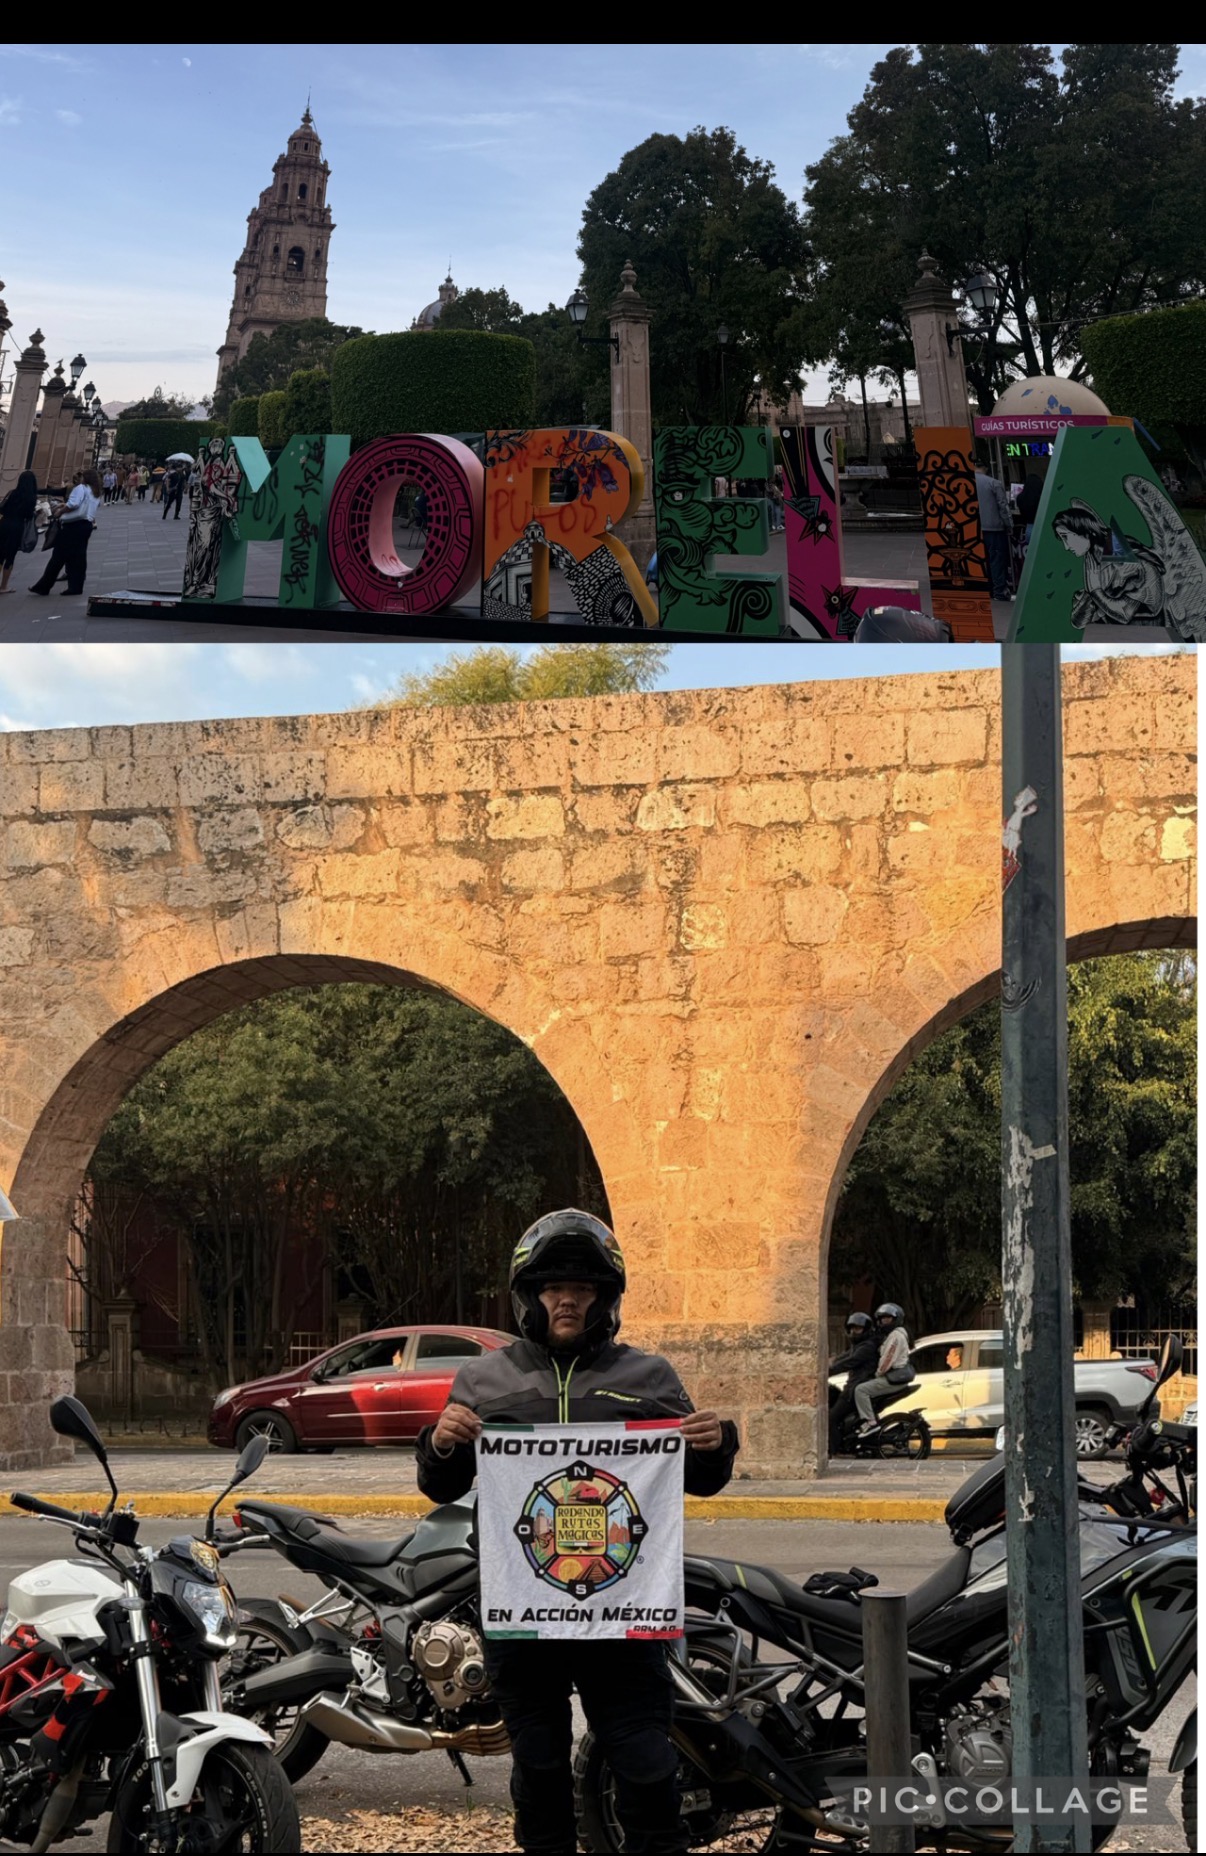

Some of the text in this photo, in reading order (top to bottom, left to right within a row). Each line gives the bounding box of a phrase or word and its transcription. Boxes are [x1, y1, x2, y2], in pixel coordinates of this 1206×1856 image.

[981, 418, 1075, 433] GUÍAS TURÍSTICOS
[182, 427, 1205, 642] MORELIA
[480, 1436, 681, 1456] MOTOTURISMO
[574, 1466, 588, 1477] N
[518, 1523, 528, 1535] O
[633, 1523, 644, 1534] E
[575, 1584, 587, 1595] S
[487, 1602, 678, 1622] EN ACCIÓN MÉXICO
